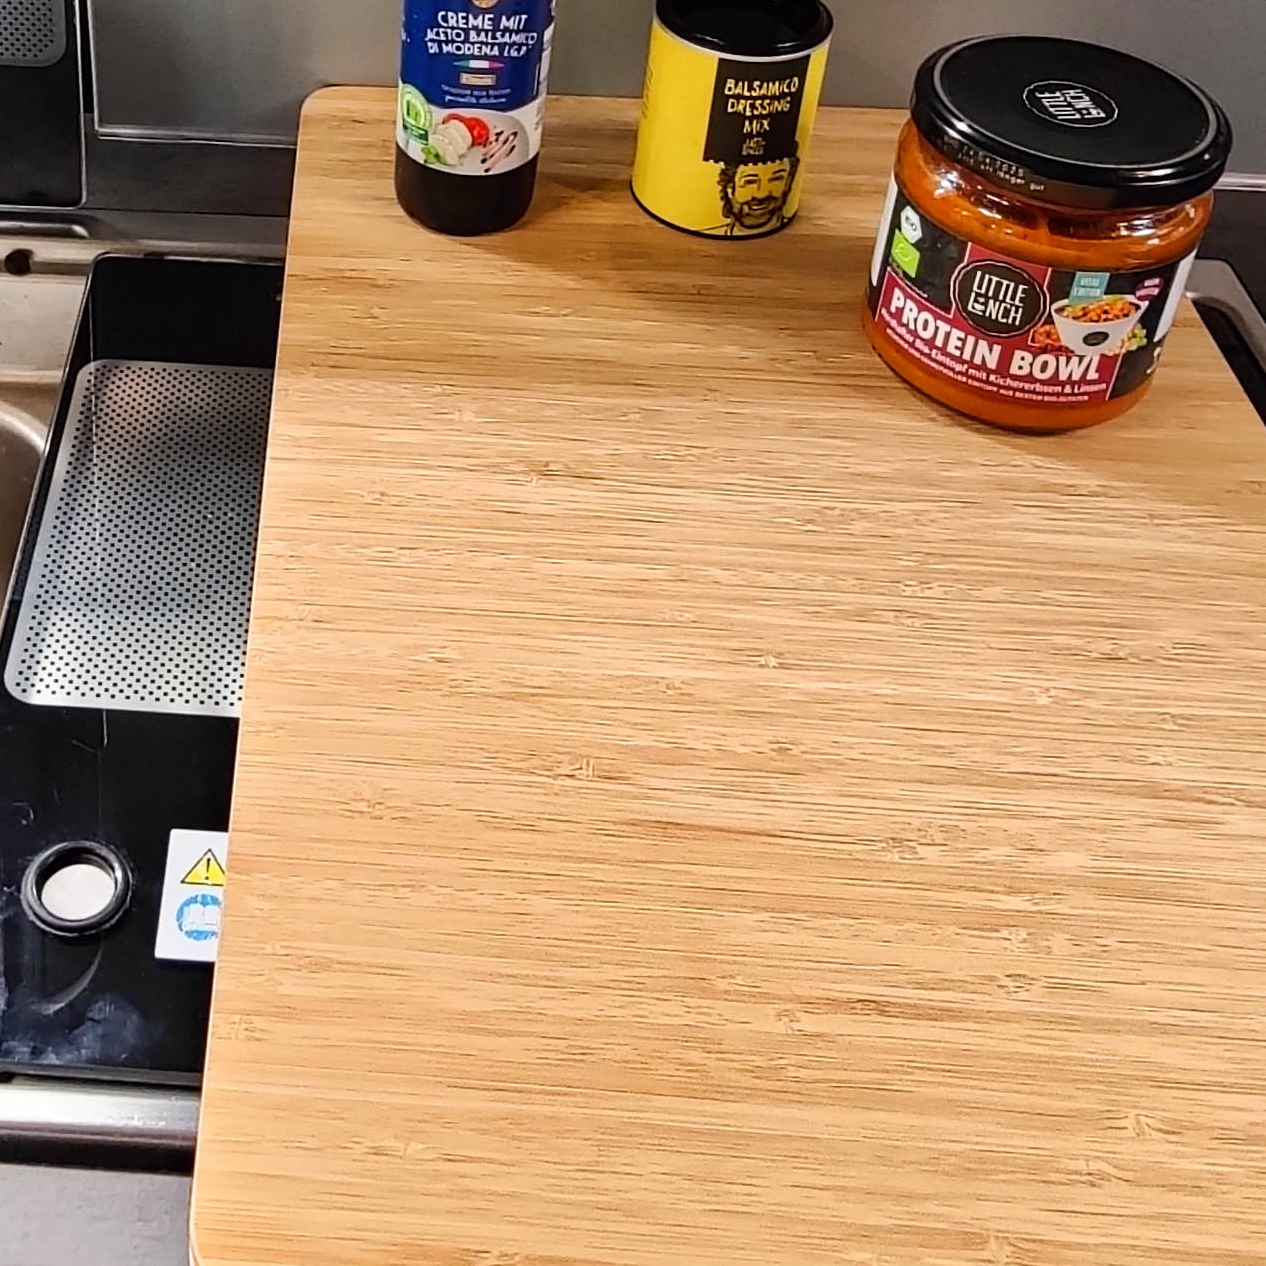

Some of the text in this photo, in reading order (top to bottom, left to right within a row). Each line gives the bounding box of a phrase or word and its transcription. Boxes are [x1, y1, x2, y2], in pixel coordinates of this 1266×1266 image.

[437, 10, 528, 30] CREME MIT
[424, 28, 537, 45] ACETO BALSAMICO
[442, 43, 499, 56] MODENA
[972, 270, 1029, 307] LITTLE
[890, 287, 1002, 370] PROTEIN
[1009, 349, 1101, 381] BOWL
[968, 368, 987, 380] mit
[988, 374, 1062, 393] Kichererbsen
